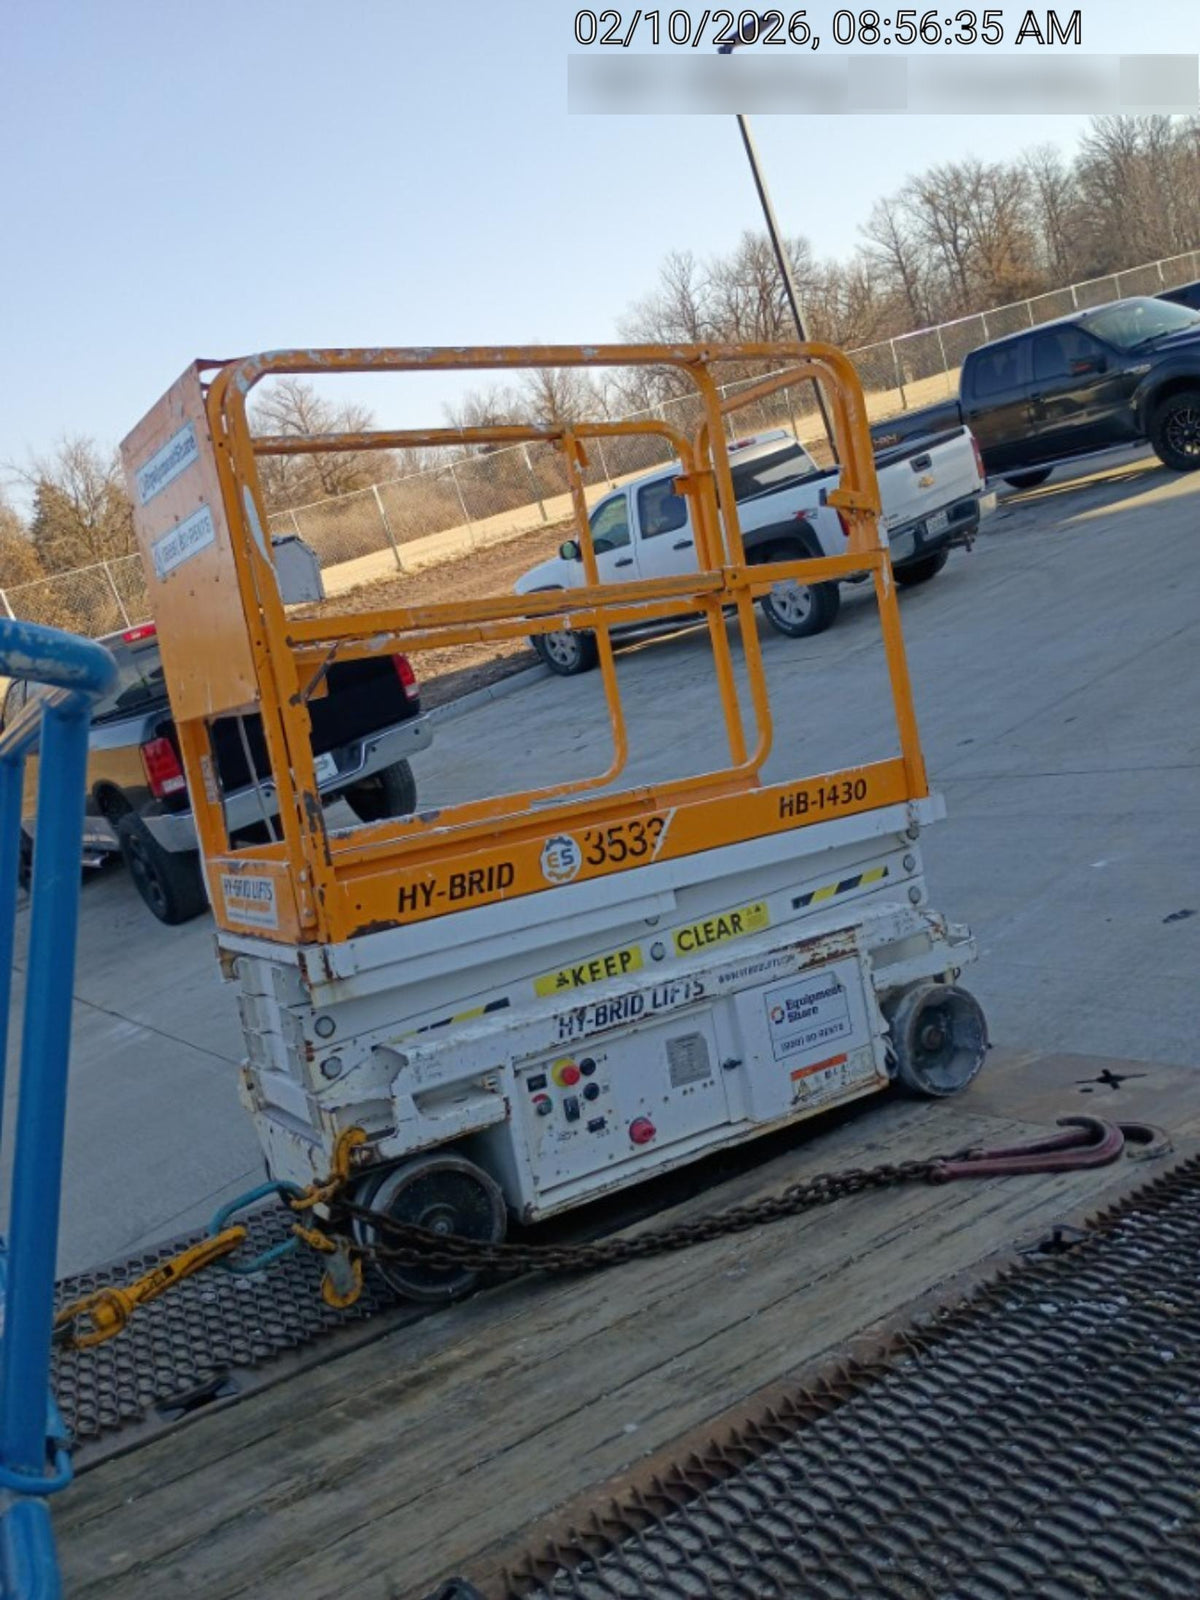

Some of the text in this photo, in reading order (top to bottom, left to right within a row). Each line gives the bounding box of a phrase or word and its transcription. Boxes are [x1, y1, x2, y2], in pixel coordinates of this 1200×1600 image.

[779, 779, 867, 818] HB-1430
[398, 862, 515, 913] HY-BRID
[571, 913, 744, 987] KEEP CLEAR
[785, 984, 843, 1011] Equipment
[787, 1005, 819, 1023] Share
